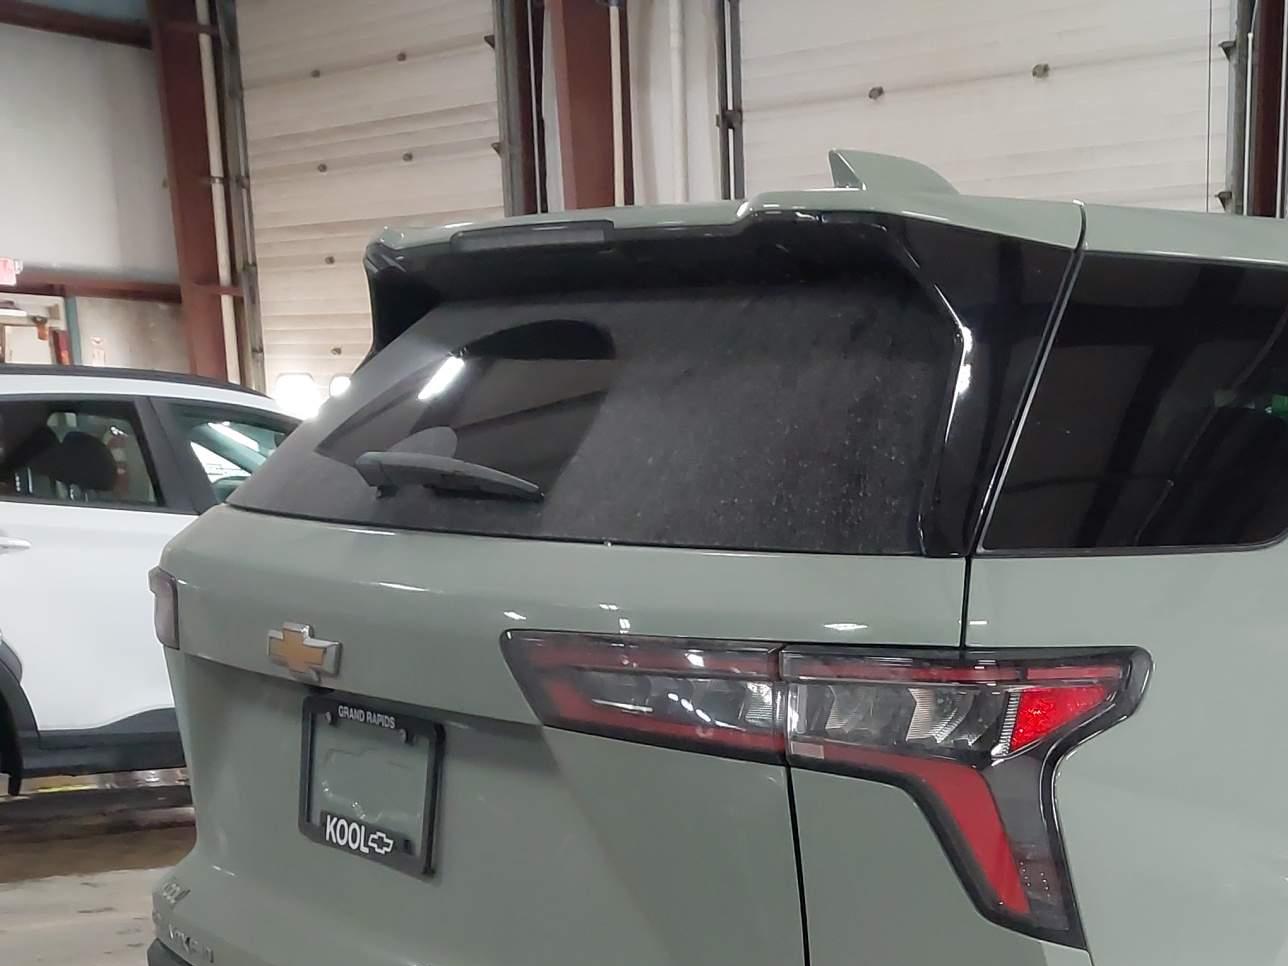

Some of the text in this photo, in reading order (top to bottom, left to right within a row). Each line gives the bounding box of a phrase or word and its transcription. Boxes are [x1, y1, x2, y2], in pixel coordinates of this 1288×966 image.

[338, 705, 396, 729] GRAND RAPIDS
[326, 814, 369, 853] KOOL
